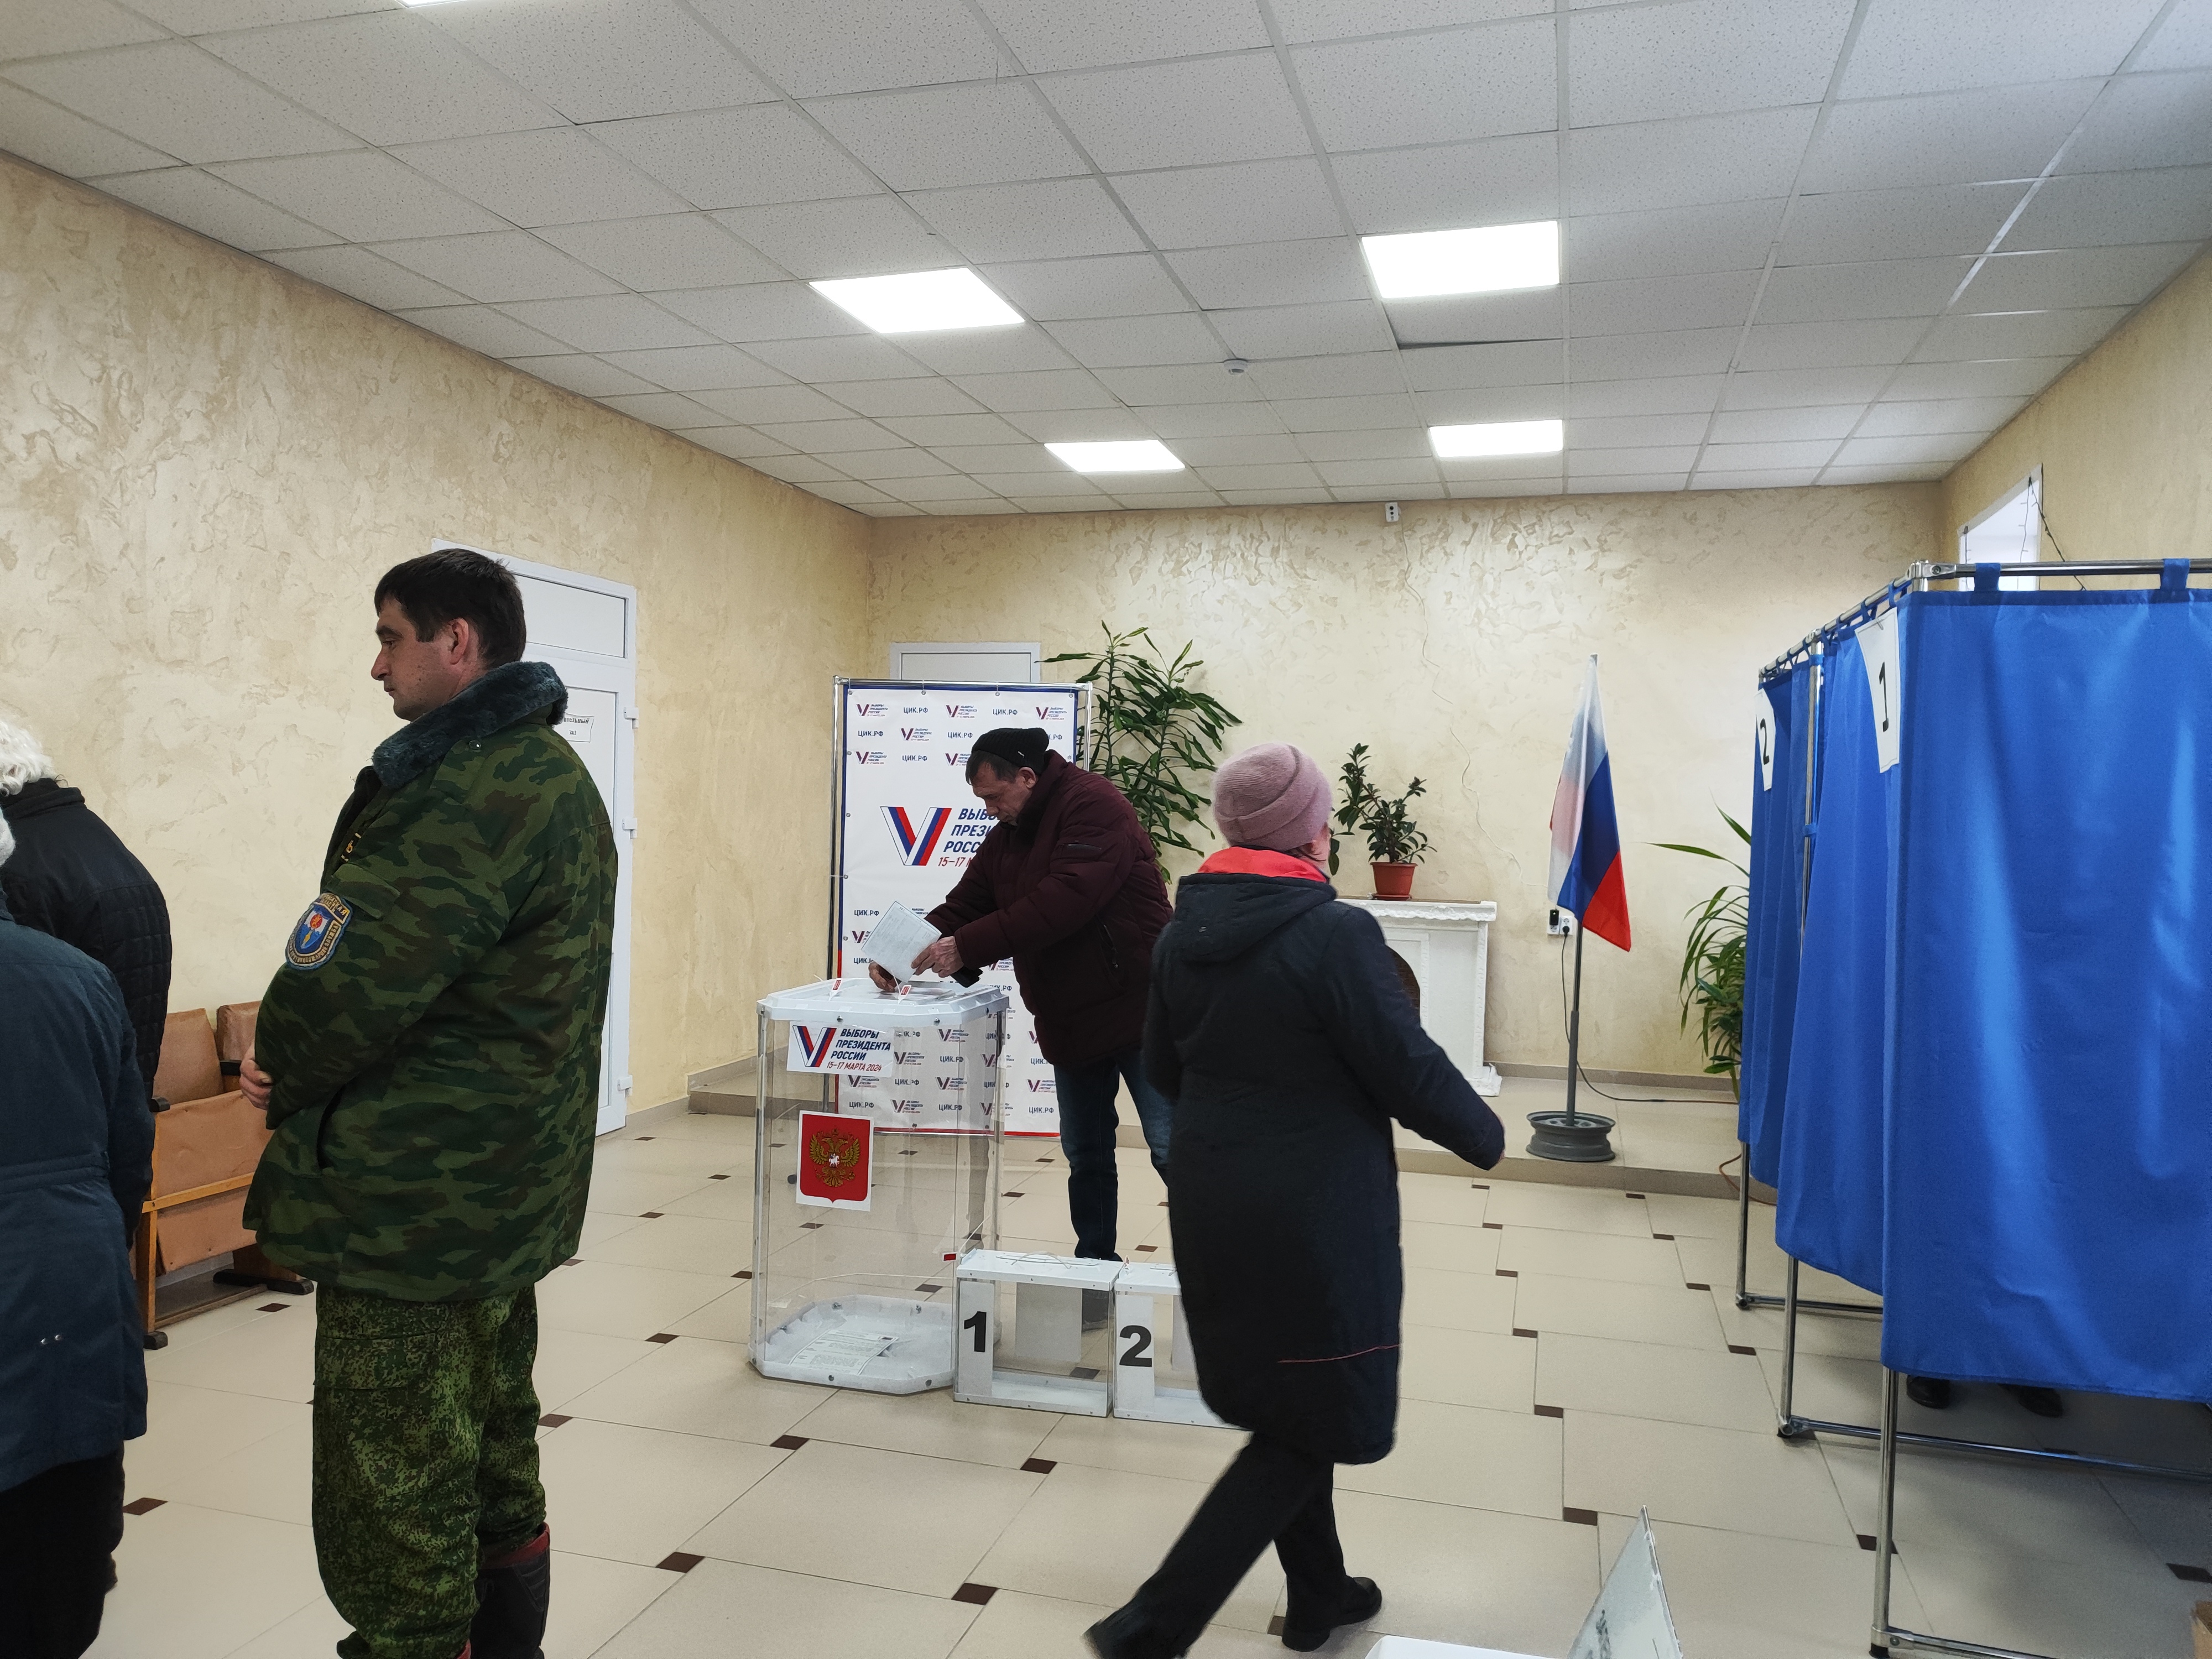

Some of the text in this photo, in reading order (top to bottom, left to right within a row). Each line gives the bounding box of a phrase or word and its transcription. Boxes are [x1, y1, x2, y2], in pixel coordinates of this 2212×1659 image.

[1879, 662, 1889, 732] 1
[1760, 718, 1770, 765] 2
[943, 841, 981, 853] РОСС
[840, 1028, 880, 1039] ВЫБОРЫ
[836, 1039, 891, 1051] ПРЕЗИДЕНТА
[831, 1050, 867, 1061] РОССИИ
[843, 1062, 865, 1071] МАРТА
[866, 1063, 882, 1072] 2024
[964, 1311, 987, 1353] 1
[1119, 1325, 1152, 1367] 2
